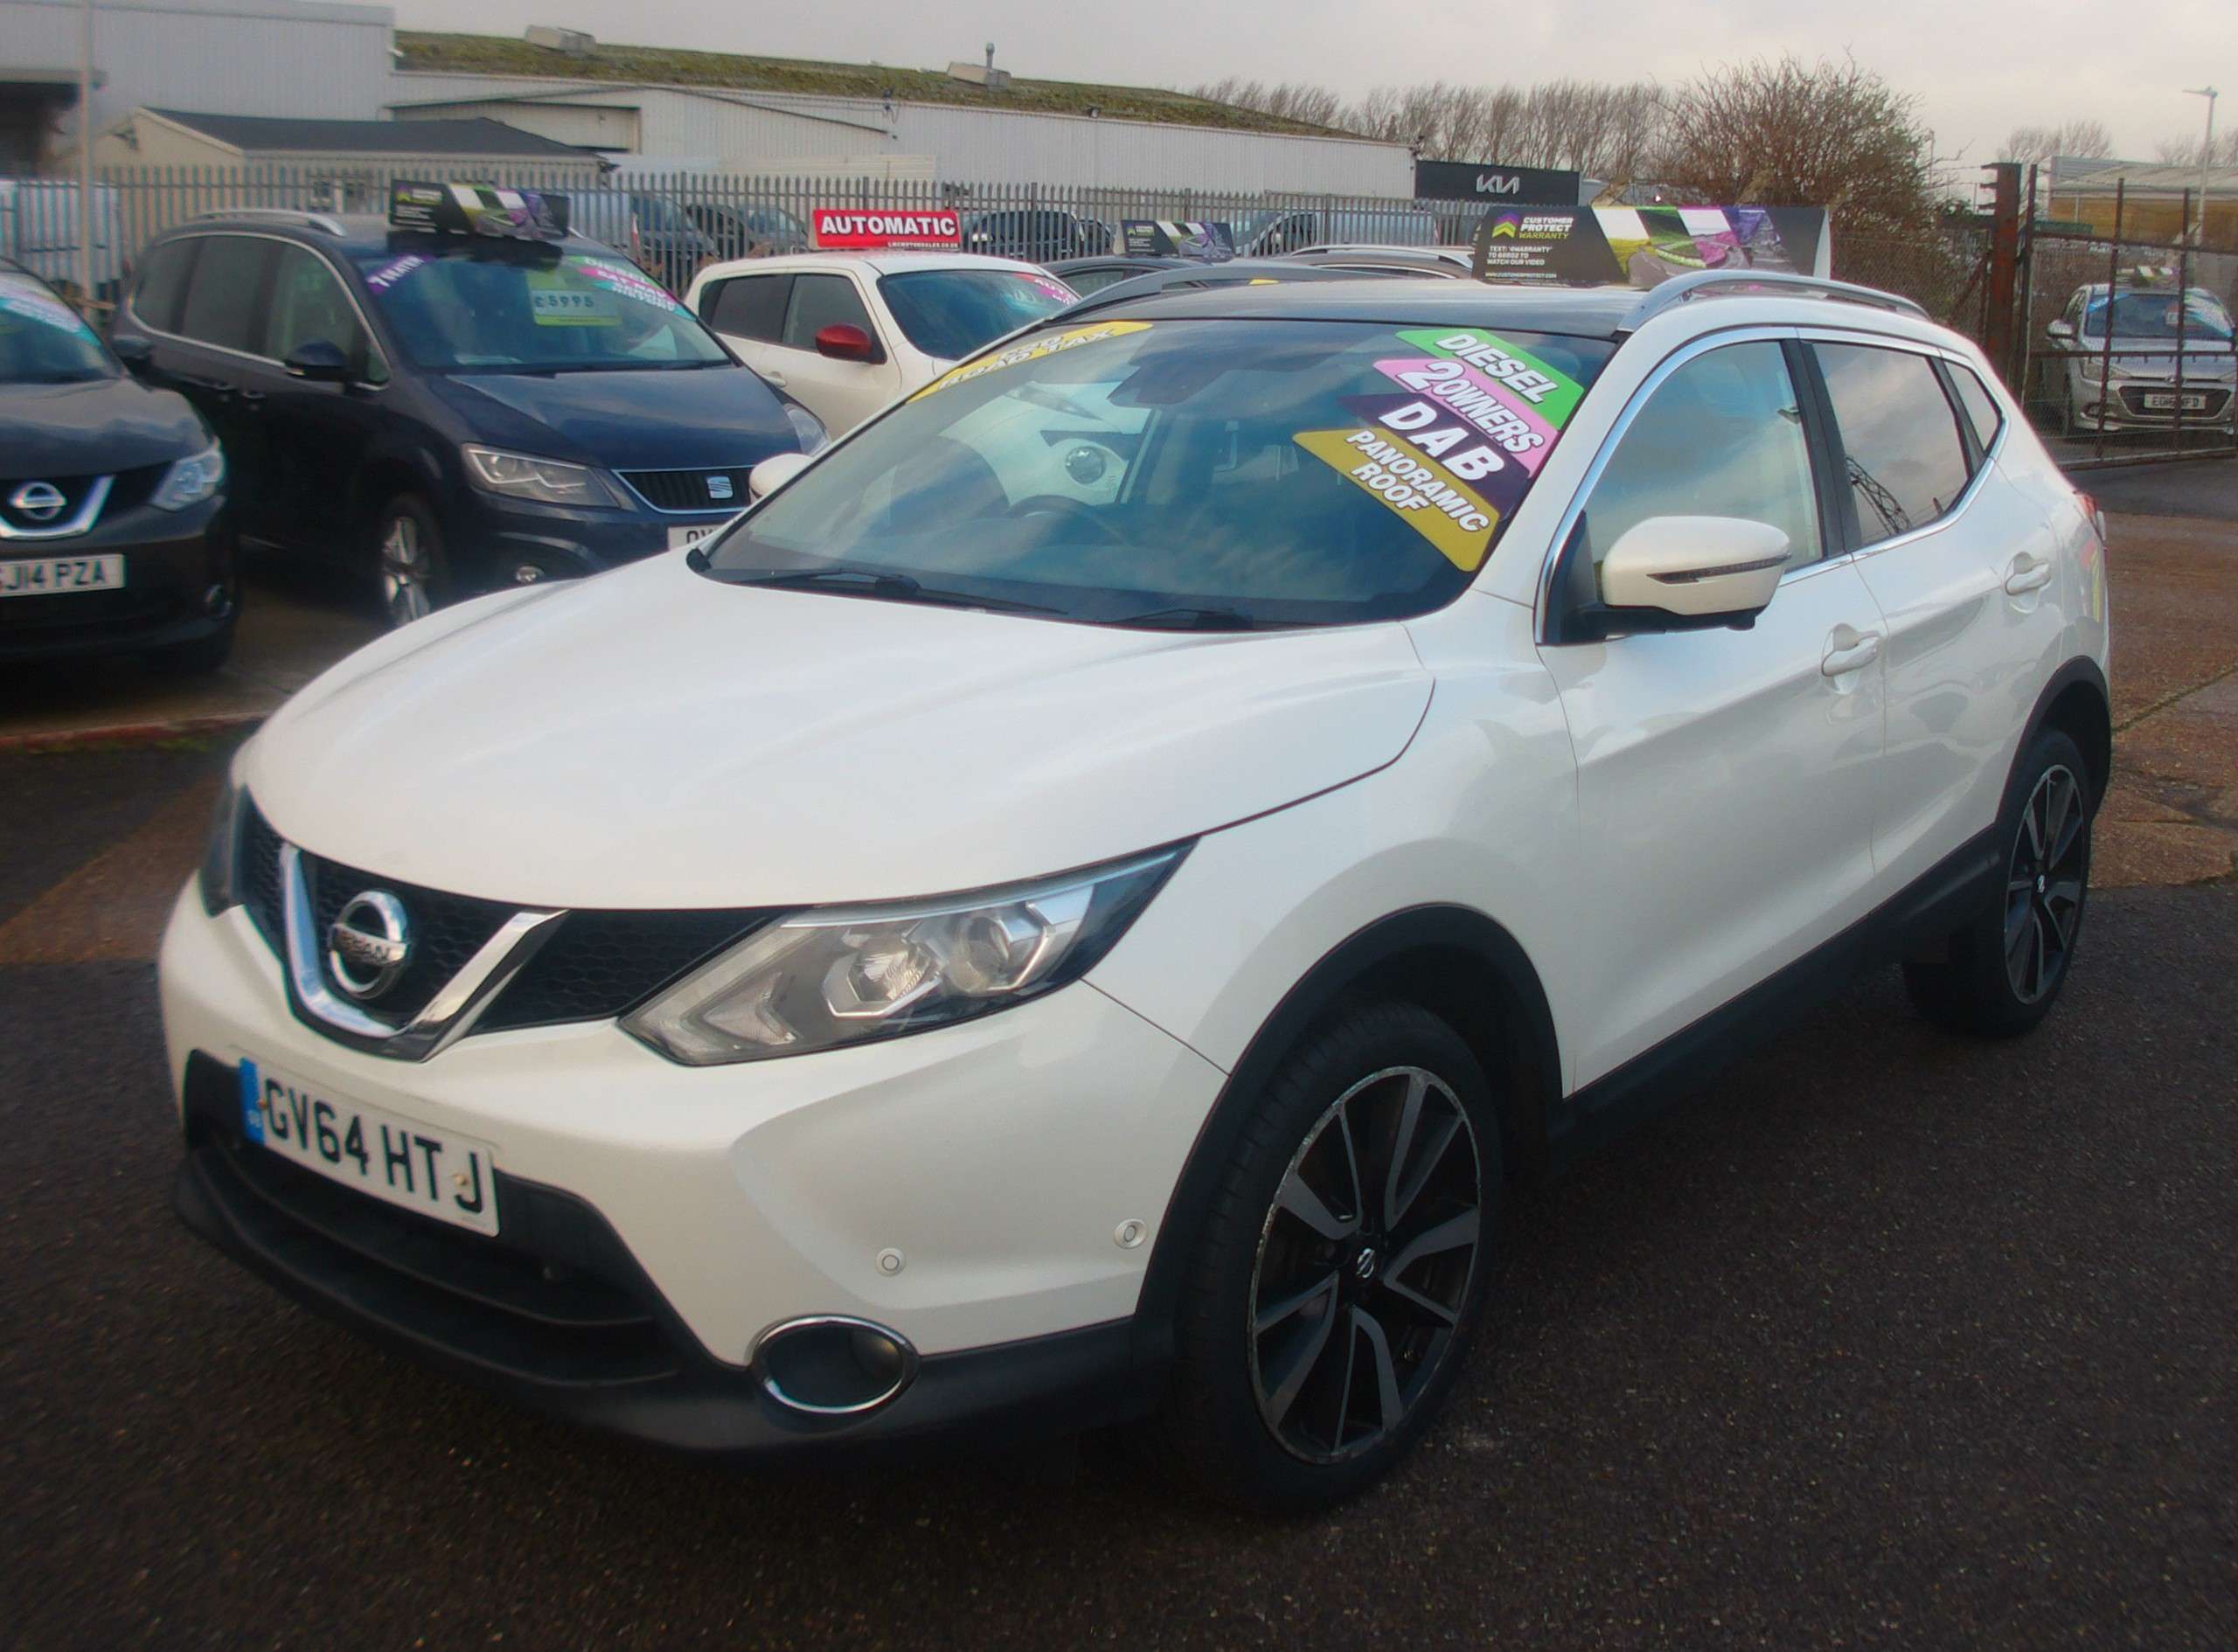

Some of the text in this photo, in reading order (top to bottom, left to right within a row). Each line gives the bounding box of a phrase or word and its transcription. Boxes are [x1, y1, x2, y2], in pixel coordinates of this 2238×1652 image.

[1476, 174, 1520, 195] KIA
[820, 215, 956, 237] AUTOMATIC
[1520, 224, 1573, 233] PROTECT
[1522, 216, 1574, 225] CUSTOMER
[366, 273, 391, 288] 7
[533, 293, 594, 308] £5995
[938, 329, 1115, 390] ROAD TAX
[1433, 333, 1559, 404] DIESEL
[1378, 400, 1505, 482] DAB
[1345, 430, 1490, 531] PANORAMIC
[1351, 462, 1430, 510] ROOF
[54, 559, 107, 587] PZA
[265, 1078, 368, 1176] GV64
